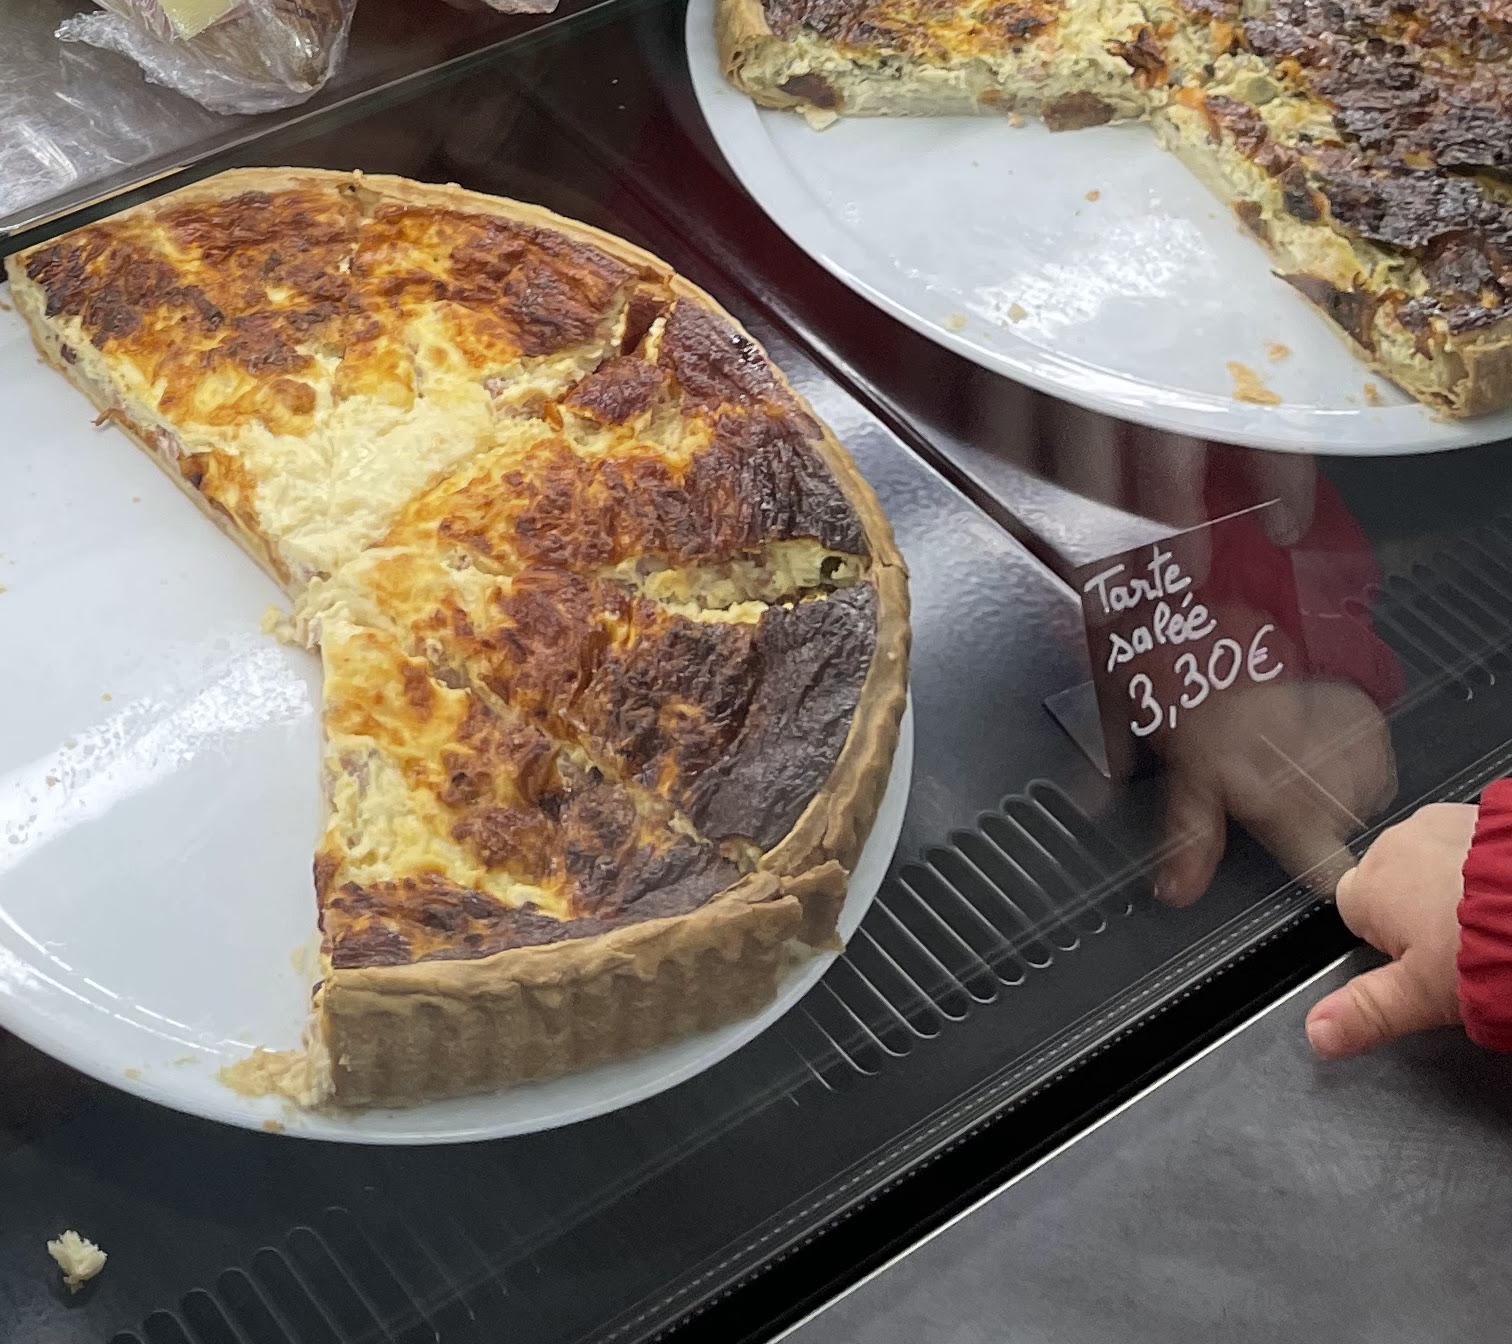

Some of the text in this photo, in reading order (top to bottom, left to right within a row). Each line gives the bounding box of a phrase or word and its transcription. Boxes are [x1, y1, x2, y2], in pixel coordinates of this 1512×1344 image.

[1084, 544, 1192, 613] Tarte
[1107, 591, 1217, 673] salée
[1129, 624, 1284, 736] 3,30€
